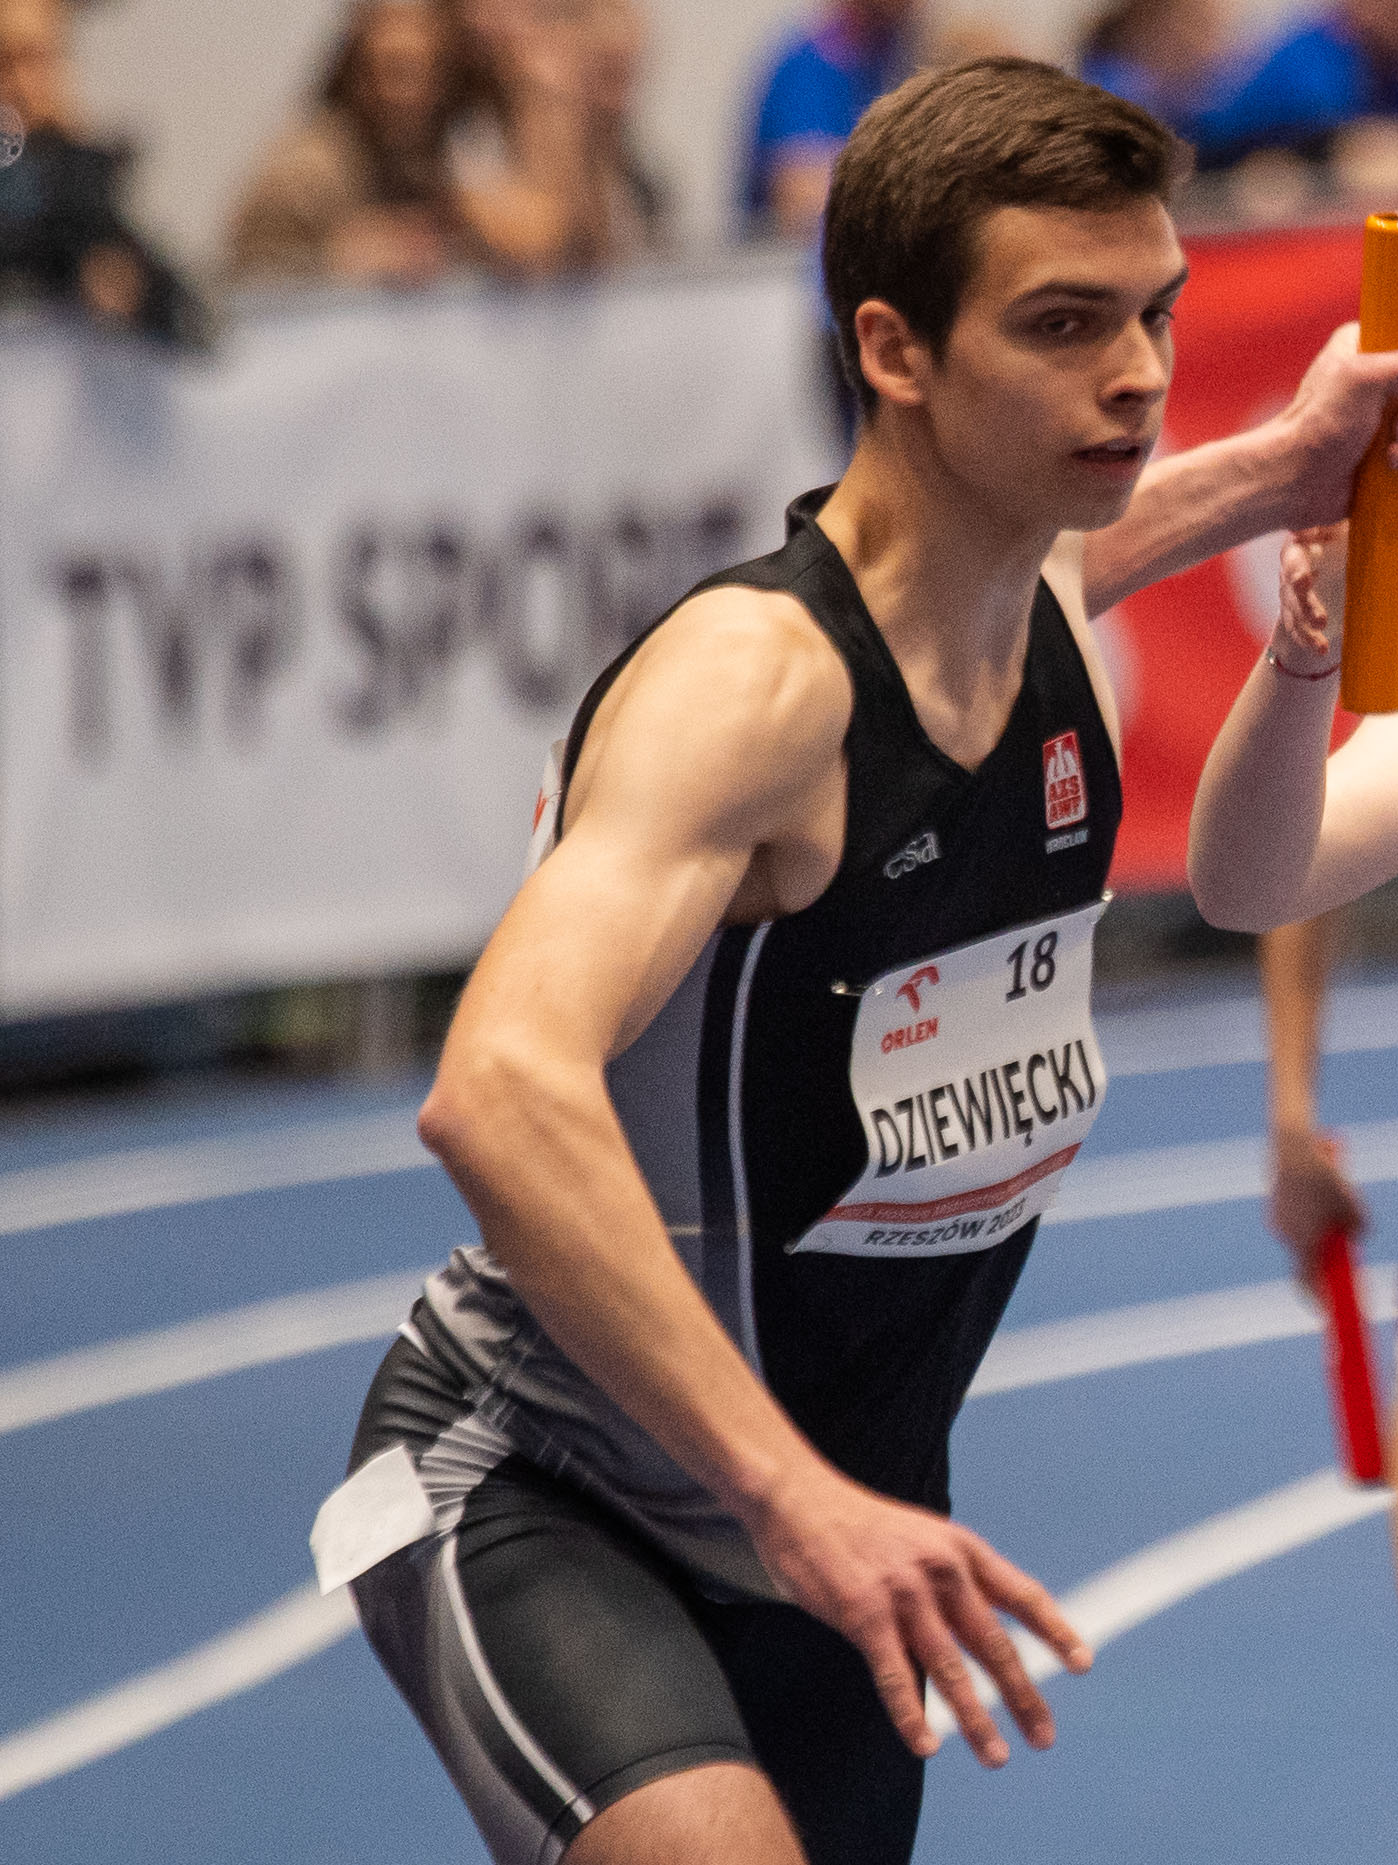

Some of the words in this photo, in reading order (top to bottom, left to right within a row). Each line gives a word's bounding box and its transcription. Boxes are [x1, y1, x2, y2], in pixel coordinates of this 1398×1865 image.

[52, 540, 286, 762] TVP
[1005, 931, 1058, 1003] 18
[880, 1015, 940, 1055] ORLEN
[869, 1039, 1096, 1179] DZIEWIĘCKI
[863, 1218, 986, 1246] RZESZÓW
